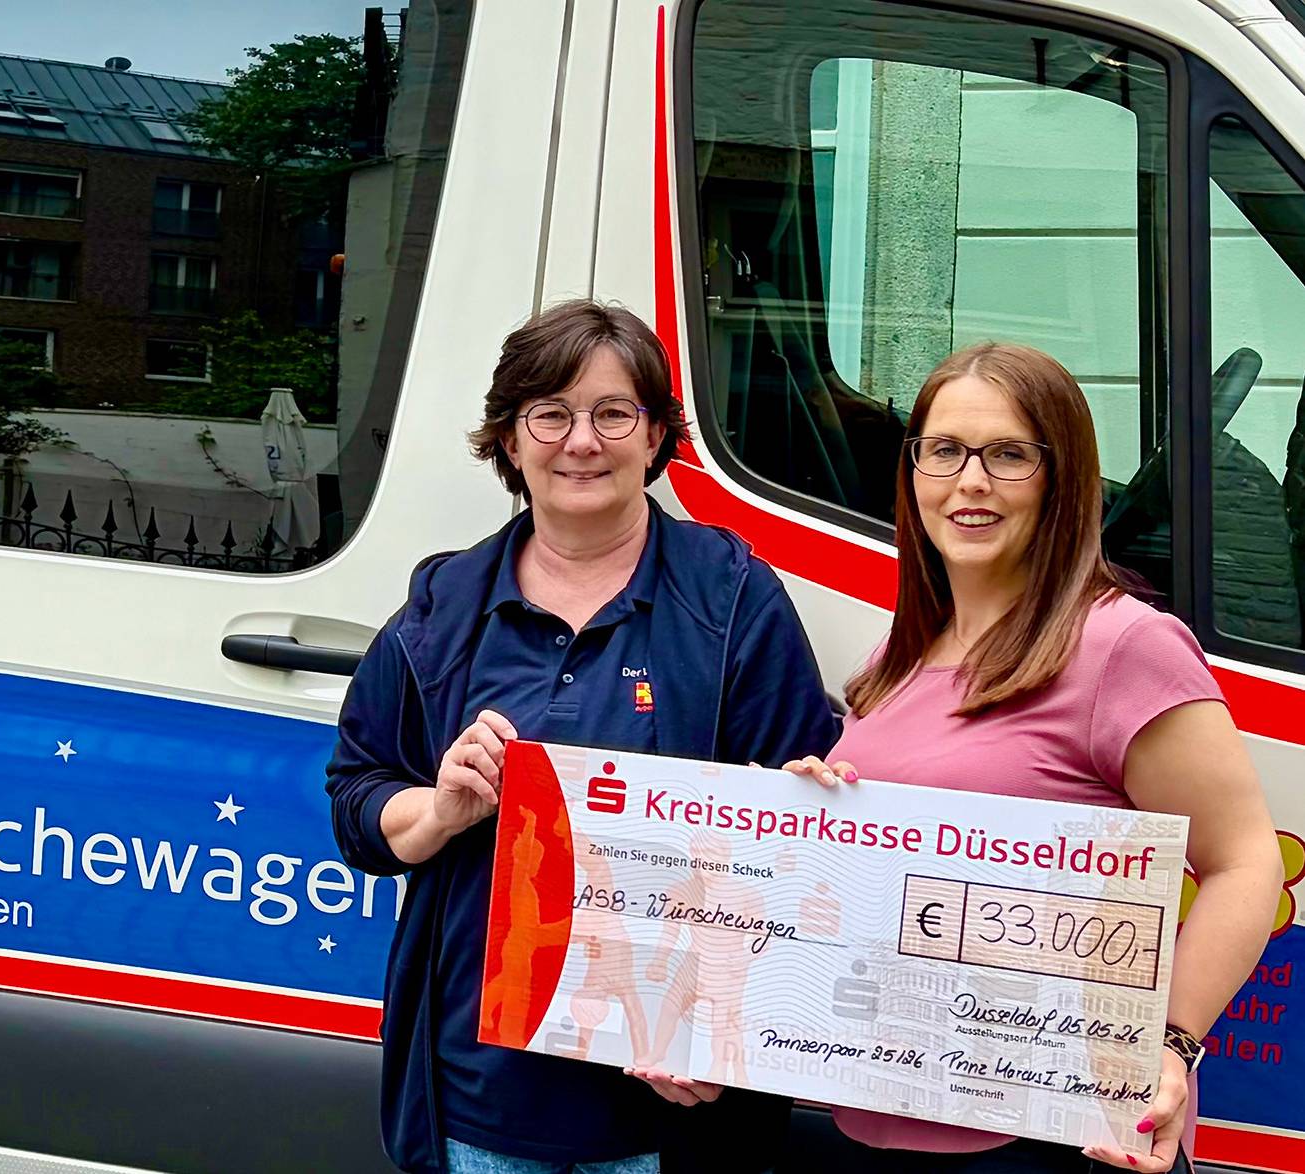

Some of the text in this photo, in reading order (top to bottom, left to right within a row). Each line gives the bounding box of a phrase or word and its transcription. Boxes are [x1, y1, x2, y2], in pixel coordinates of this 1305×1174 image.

[622, 667, 642, 677] Der
[645, 789, 922, 852] Kreissparkasse
[936, 824, 1156, 881] Düsseldorf
[589, 844, 774, 878] Zahlen Sie gegen diesen Scheck
[916, 902, 944, 938] €
[978, 901, 1158, 968] 33.000,-
[1248, 962, 1292, 987] nd
[948, 993, 1057, 1040] Düsseldorf
[1225, 994, 1287, 1024] uhr
[955, 1025, 1027, 1044] Ausstellungsort
[1035, 1037, 1066, 1049] Datum
[1201, 1032, 1282, 1065] alen
[760, 1029, 866, 1063] Prinzenpaar
[871, 1045, 925, 1069] 25/26
[939, 1050, 987, 1075] Prinz
[995, 1057, 1042, 1084] Marcus
[950, 1084, 1004, 1100] Unterschrift
